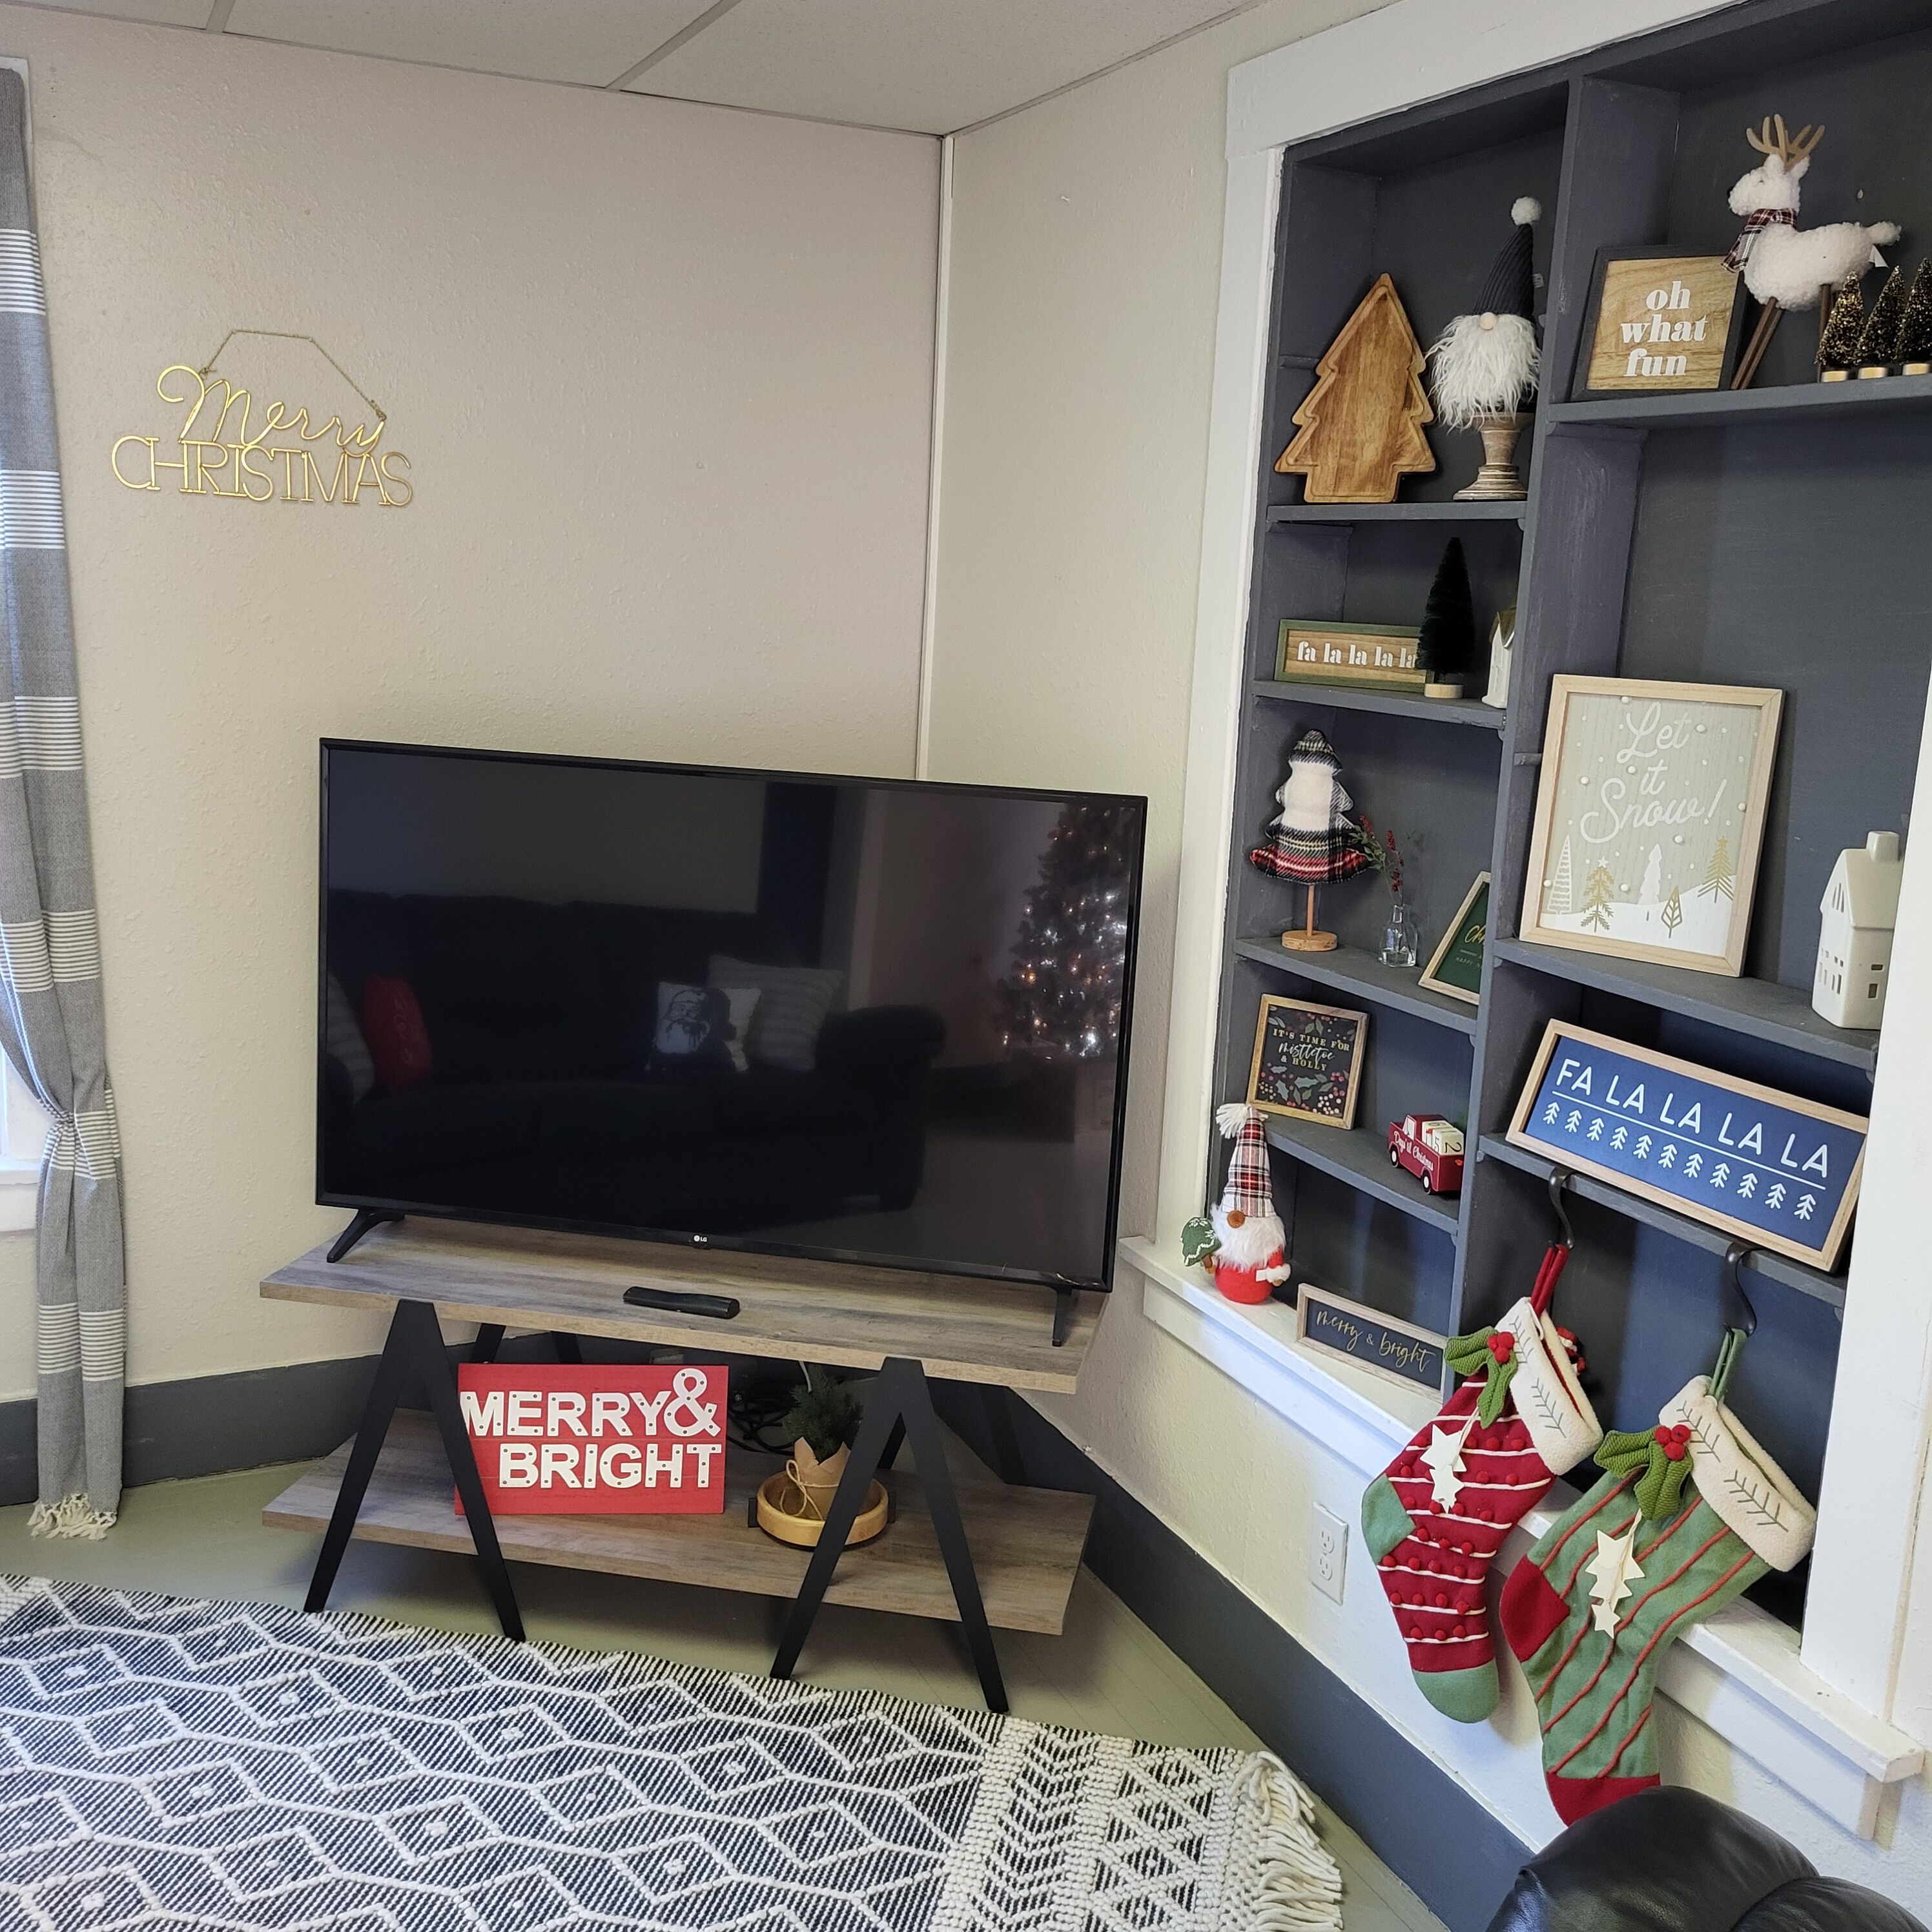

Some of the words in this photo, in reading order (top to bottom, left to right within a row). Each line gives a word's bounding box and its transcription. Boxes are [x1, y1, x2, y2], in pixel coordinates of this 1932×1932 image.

[1646, 280, 1690, 311] oh
[1620, 314, 1708, 344] what
[1623, 348, 1687, 376] fun
[157, 364, 385, 458] Merry
[111, 435, 413, 507] CHRISTMAS
[1297, 641, 1317, 662] fa
[1323, 643, 1342, 664] la
[1348, 644, 1368, 666] la
[1374, 646, 1393, 668] la
[1398, 648, 1416, 669] la
[1616, 701, 1692, 764] Let
[1639, 759, 1669, 796] it
[1579, 777, 1728, 844] Snow!
[1273, 1028, 1295, 1040] IT'S
[1299, 1034, 1327, 1047] TIME
[1330, 1040, 1350, 1052] FOR
[1280, 1055, 1288, 1064] &
[1292, 1056, 1327, 1072] HOLLY
[1556, 1058, 1592, 1096] FA
[1606, 1075, 1645, 1115] LA
[1660, 1093, 1701, 1135] LA
[1718, 1113, 1763, 1156] LA
[1780, 1133, 1829, 1178] LA
[1366, 1333, 1375, 1346] &
[1379, 1332, 1436, 1373] bright
[499, 1443, 723, 1488] BRIGHT
